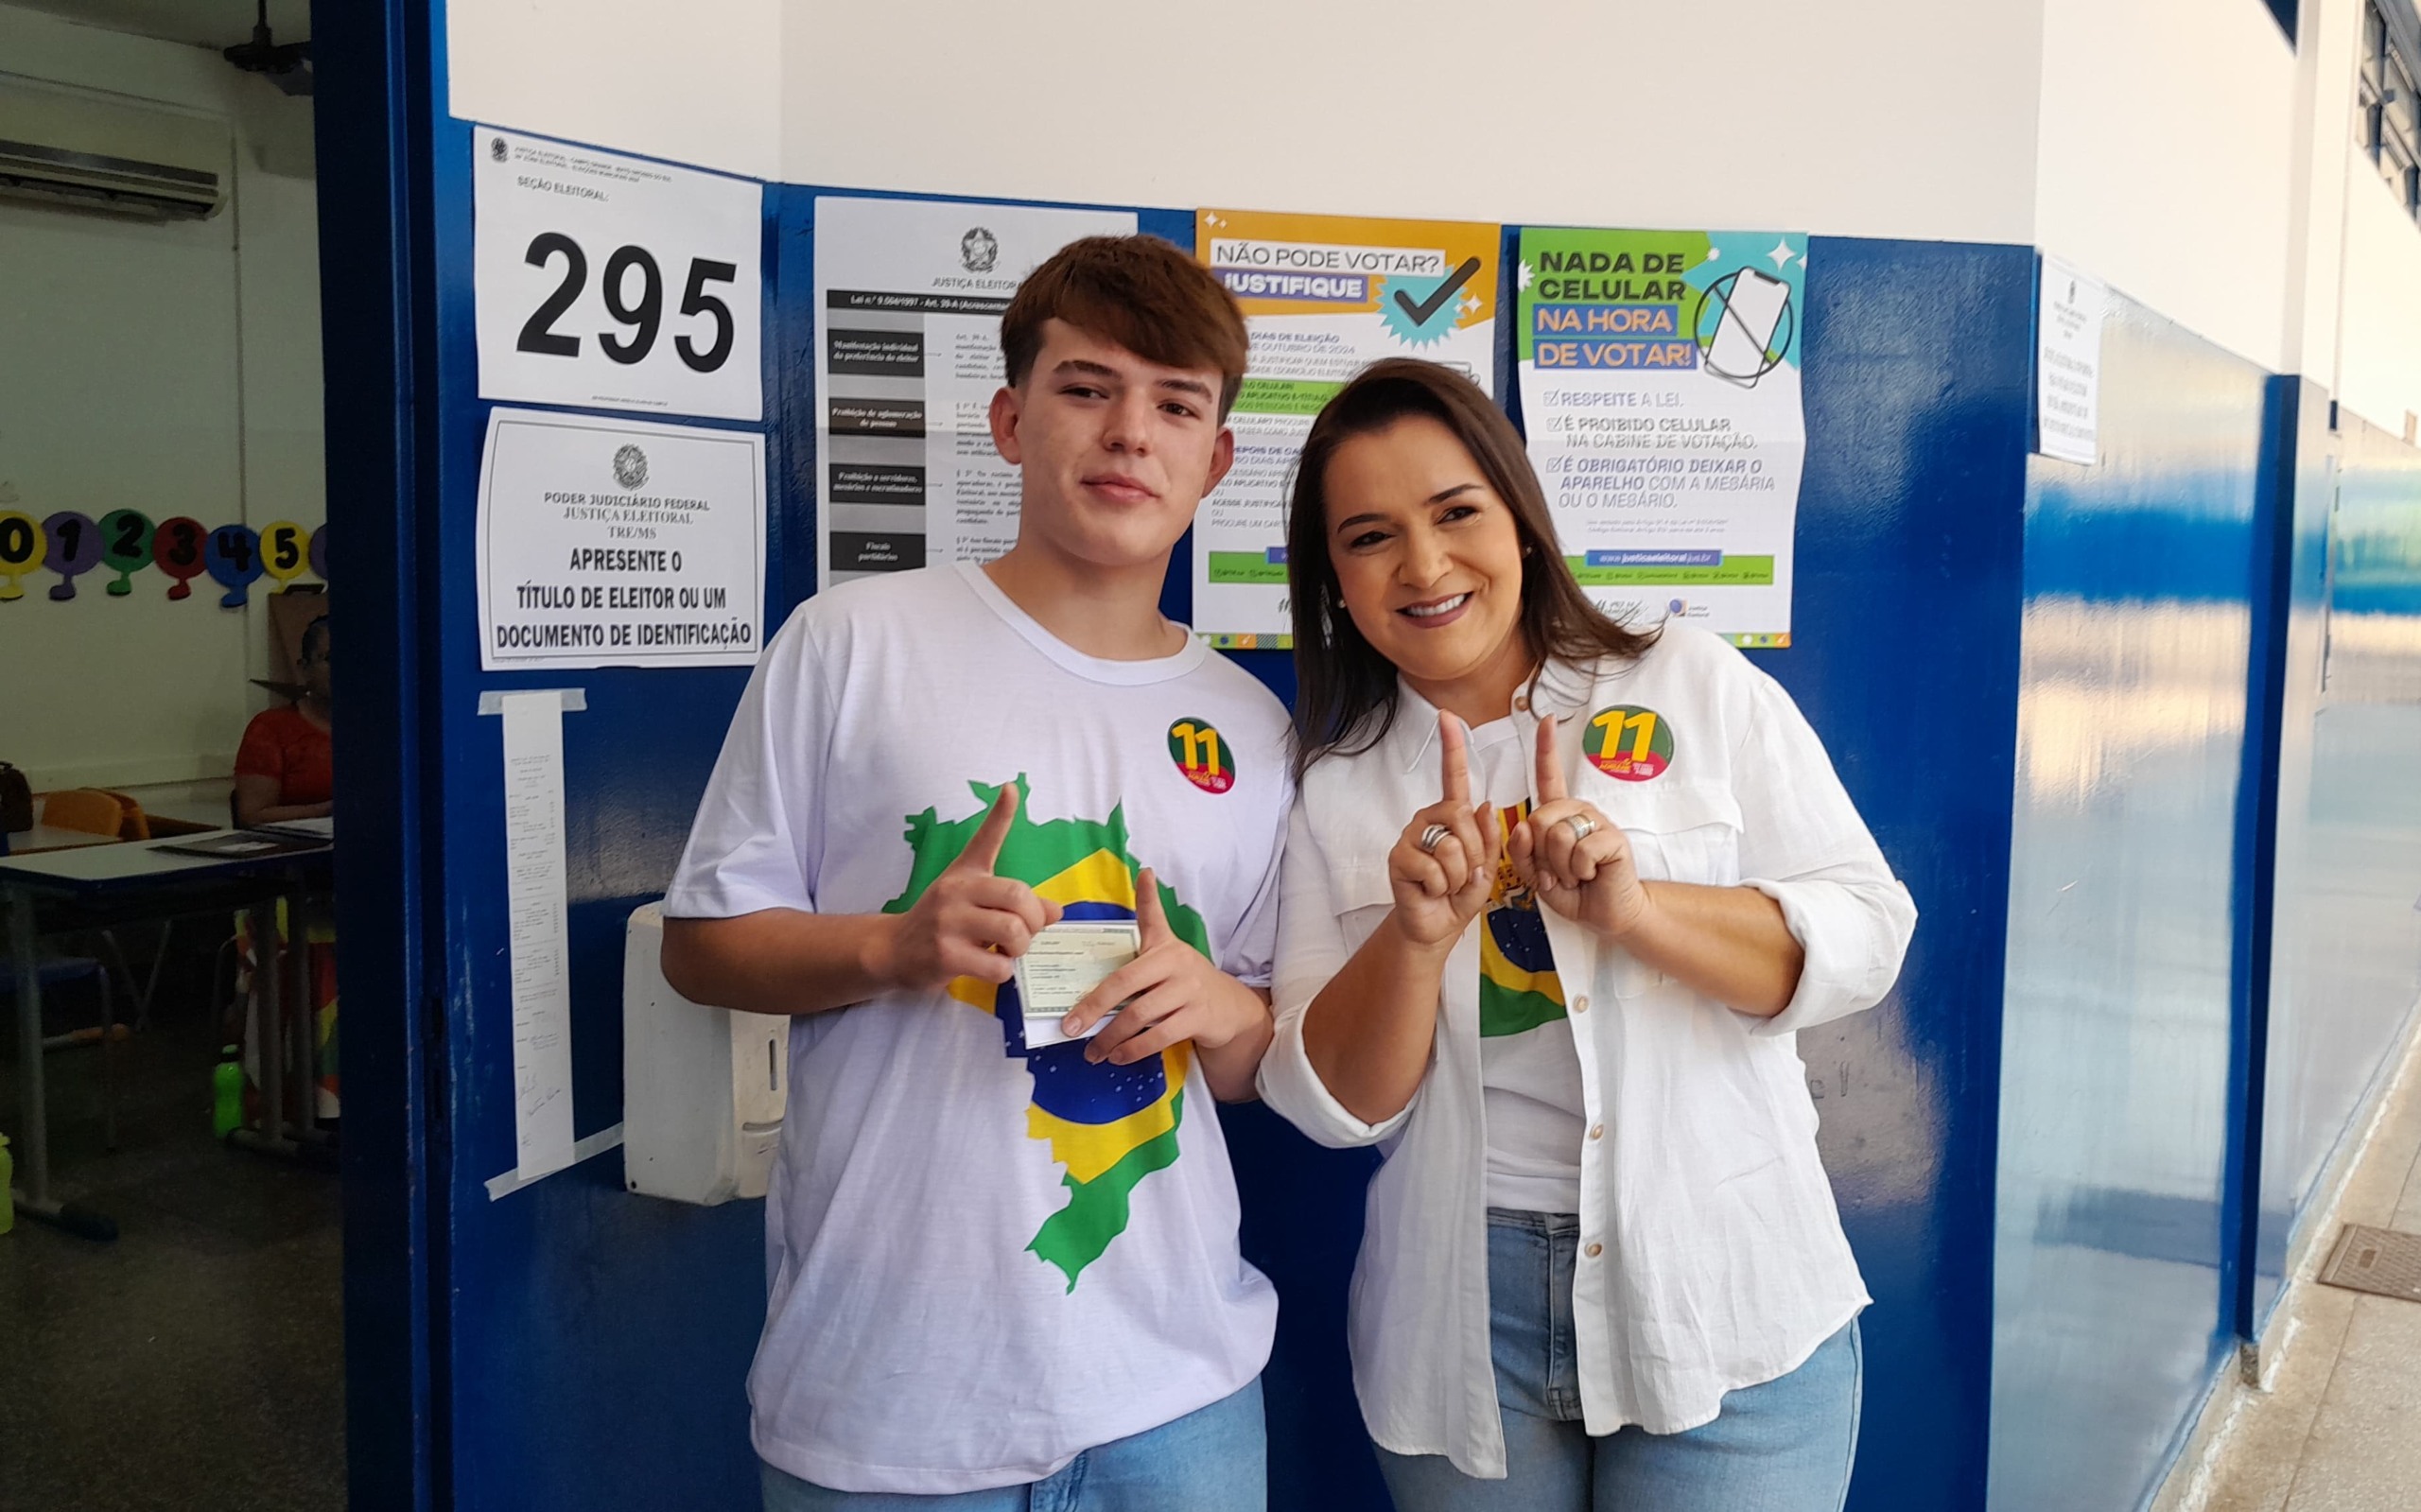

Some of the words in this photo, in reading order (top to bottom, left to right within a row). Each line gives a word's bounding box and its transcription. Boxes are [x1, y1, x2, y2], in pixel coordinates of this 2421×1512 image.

[517, 175, 552, 191] SEÇÃO
[1216, 242, 1270, 266] NÃO
[1276, 247, 1340, 269] PODE
[1344, 250, 1441, 273] VOTAR?
[1540, 252, 1635, 274] NADA
[1643, 252, 1686, 274] DE
[932, 277, 974, 290] JUSTIÇA
[975, 278, 1022, 292] ELEITOR
[1539, 278, 1687, 302] CELULAR
[516, 232, 737, 373] 295
[1537, 307, 1582, 333] NA
[1587, 308, 1673, 333] HORA
[1261, 342, 1312, 353] OUTUBRO
[1278, 332, 1293, 341] DE
[1294, 332, 1340, 343] ELEIÇÃO
[1538, 342, 1578, 367] DE
[1582, 343, 1692, 368] VOTAR!
[1561, 391, 1637, 408] RESPEITE
[1641, 392, 1653, 408] A
[1656, 392, 1684, 408] LEI.
[1563, 414, 1573, 431] É
[1577, 417, 1655, 432] PROIBIDO
[1658, 418, 1732, 432] CELULAR
[1234, 445, 1266, 455] EPOIS
[1566, 434, 1589, 448] NA
[1593, 434, 1652, 449] CABINE
[1655, 434, 1677, 449] DE
[1680, 431, 1759, 454] VOTAÇÃO.
[1563, 455, 1573, 473] É
[1576, 455, 1684, 473] OBRIGATÓRIO
[1688, 458, 1747, 473] DEIXAR
[1750, 459, 1763, 473] O
[1559, 476, 1646, 492] APARELHO
[1648, 476, 1686, 492] COM
[1689, 477, 1701, 491] A
[1703, 474, 1776, 492] MESÁRIA
[544, 492, 585, 505] PODER
[590, 494, 661, 509] JUDICIÁRIO
[664, 497, 710, 512] FEDERAL
[1559, 492, 1583, 509] OU
[1586, 492, 1598, 508] O
[1602, 490, 1679, 509] MESÁRIO.
[562, 507, 618, 523] JUSTIÇA
[622, 509, 693, 525] ELEITORAL
[0, 517, 34, 564] 0
[57, 519, 82, 562] 1
[112, 514, 145, 559] 2
[168, 523, 198, 566] 3
[218, 531, 252, 571] 4
[274, 528, 300, 570] 5
[607, 525, 656, 540] TRE/MS
[570, 547, 666, 572] APRESENTE
[671, 550, 683, 572] O
[516, 580, 575, 609] TÍTULO
[581, 586, 603, 609] DE
[609, 587, 674, 609] ELEITOR
[679, 587, 700, 609] OU
[704, 587, 726, 609] UM
[496, 624, 604, 648] DOCUMENTO
[610, 624, 632, 647] DE
[637, 617, 751, 650] IDENTIFICAÇÃO
[1591, 710, 1657, 762] 11
[1171, 722, 1220, 775] 11
